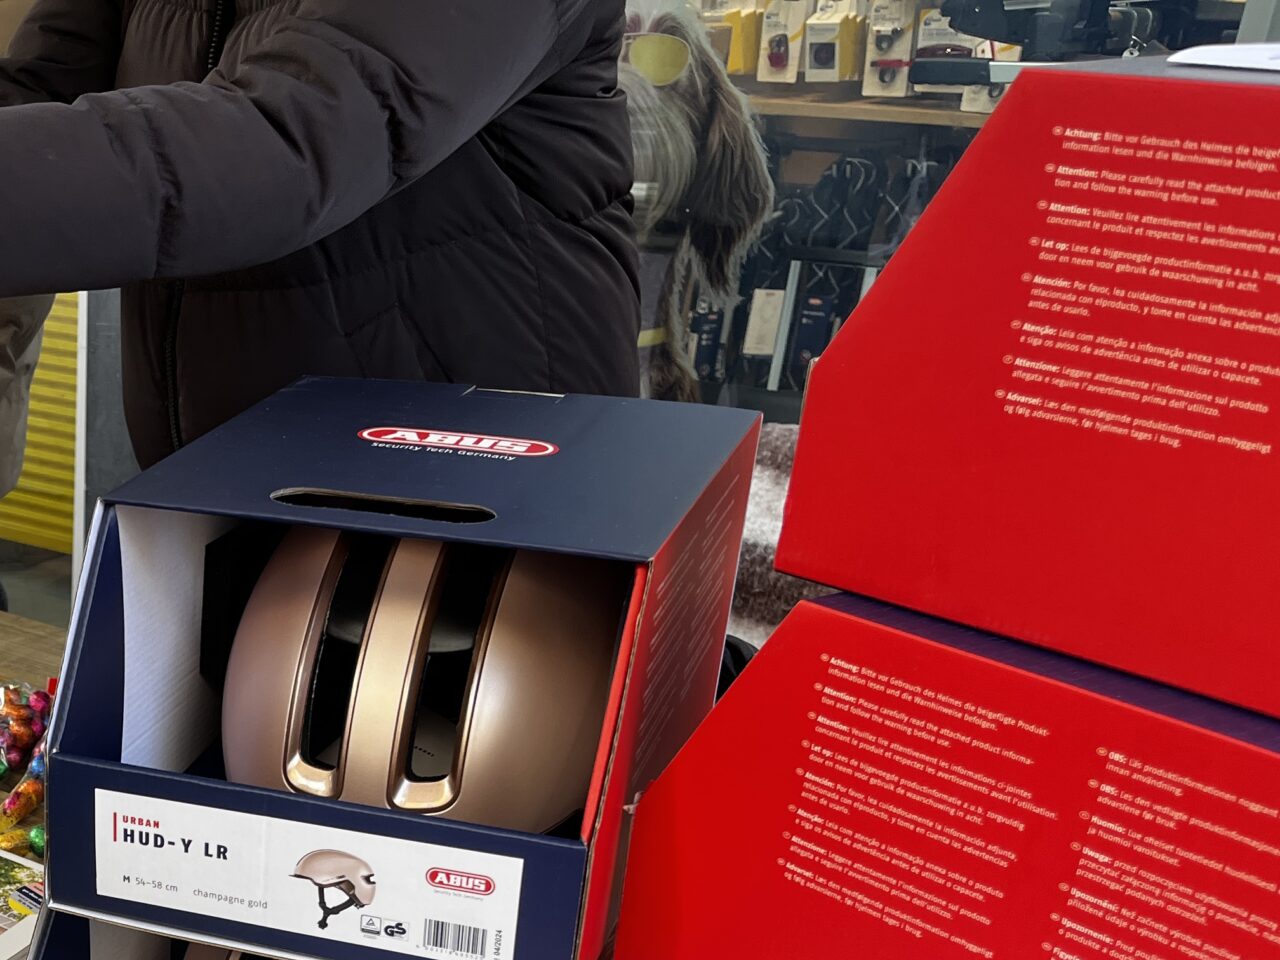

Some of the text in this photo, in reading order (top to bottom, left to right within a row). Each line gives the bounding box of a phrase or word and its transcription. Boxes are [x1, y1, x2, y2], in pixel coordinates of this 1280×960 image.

[1054, 179, 1219, 206] tion and follow the warning before use.
[1057, 165, 1243, 196] Attention: Please carefully read the attached
[371, 442, 422, 451] Security
[458, 450, 516, 460] Germany
[384, 430, 531, 453] ABUS
[824, 686, 857, 704] Attention:
[858, 698, 879, 711] Please
[880, 703, 909, 722] carefully
[909, 715, 925, 727] read
[927, 720, 938, 731] the
[940, 724, 970, 744] attached
[972, 739, 1001, 754] product
[123, 815, 159, 828] URBAN
[123, 828, 228, 860] HUD-Y LR
[123, 875, 130, 883] M
[166, 884, 178, 892] cm
[193, 888, 245, 905] champagne
[248, 899, 267, 909] gold
[434, 873, 486, 891] ABUS
